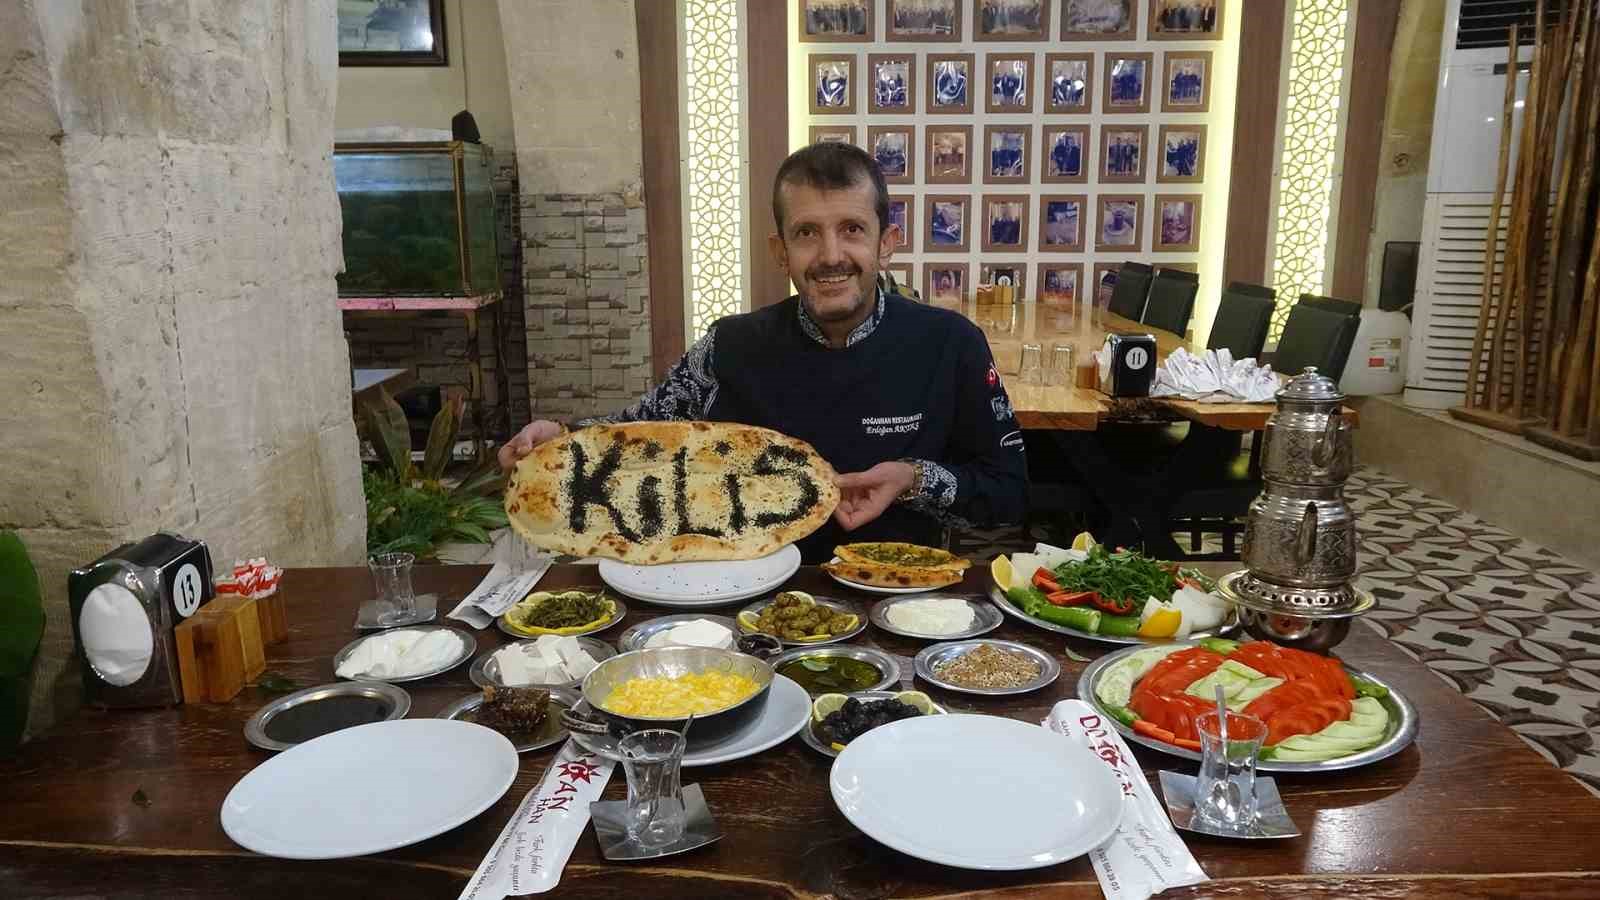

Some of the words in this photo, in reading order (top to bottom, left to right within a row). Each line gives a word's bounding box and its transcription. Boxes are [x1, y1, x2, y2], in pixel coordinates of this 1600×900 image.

[1131, 351, 1141, 365] 11
[180, 574, 195, 609] 13
[527, 798, 552, 824] HAN
